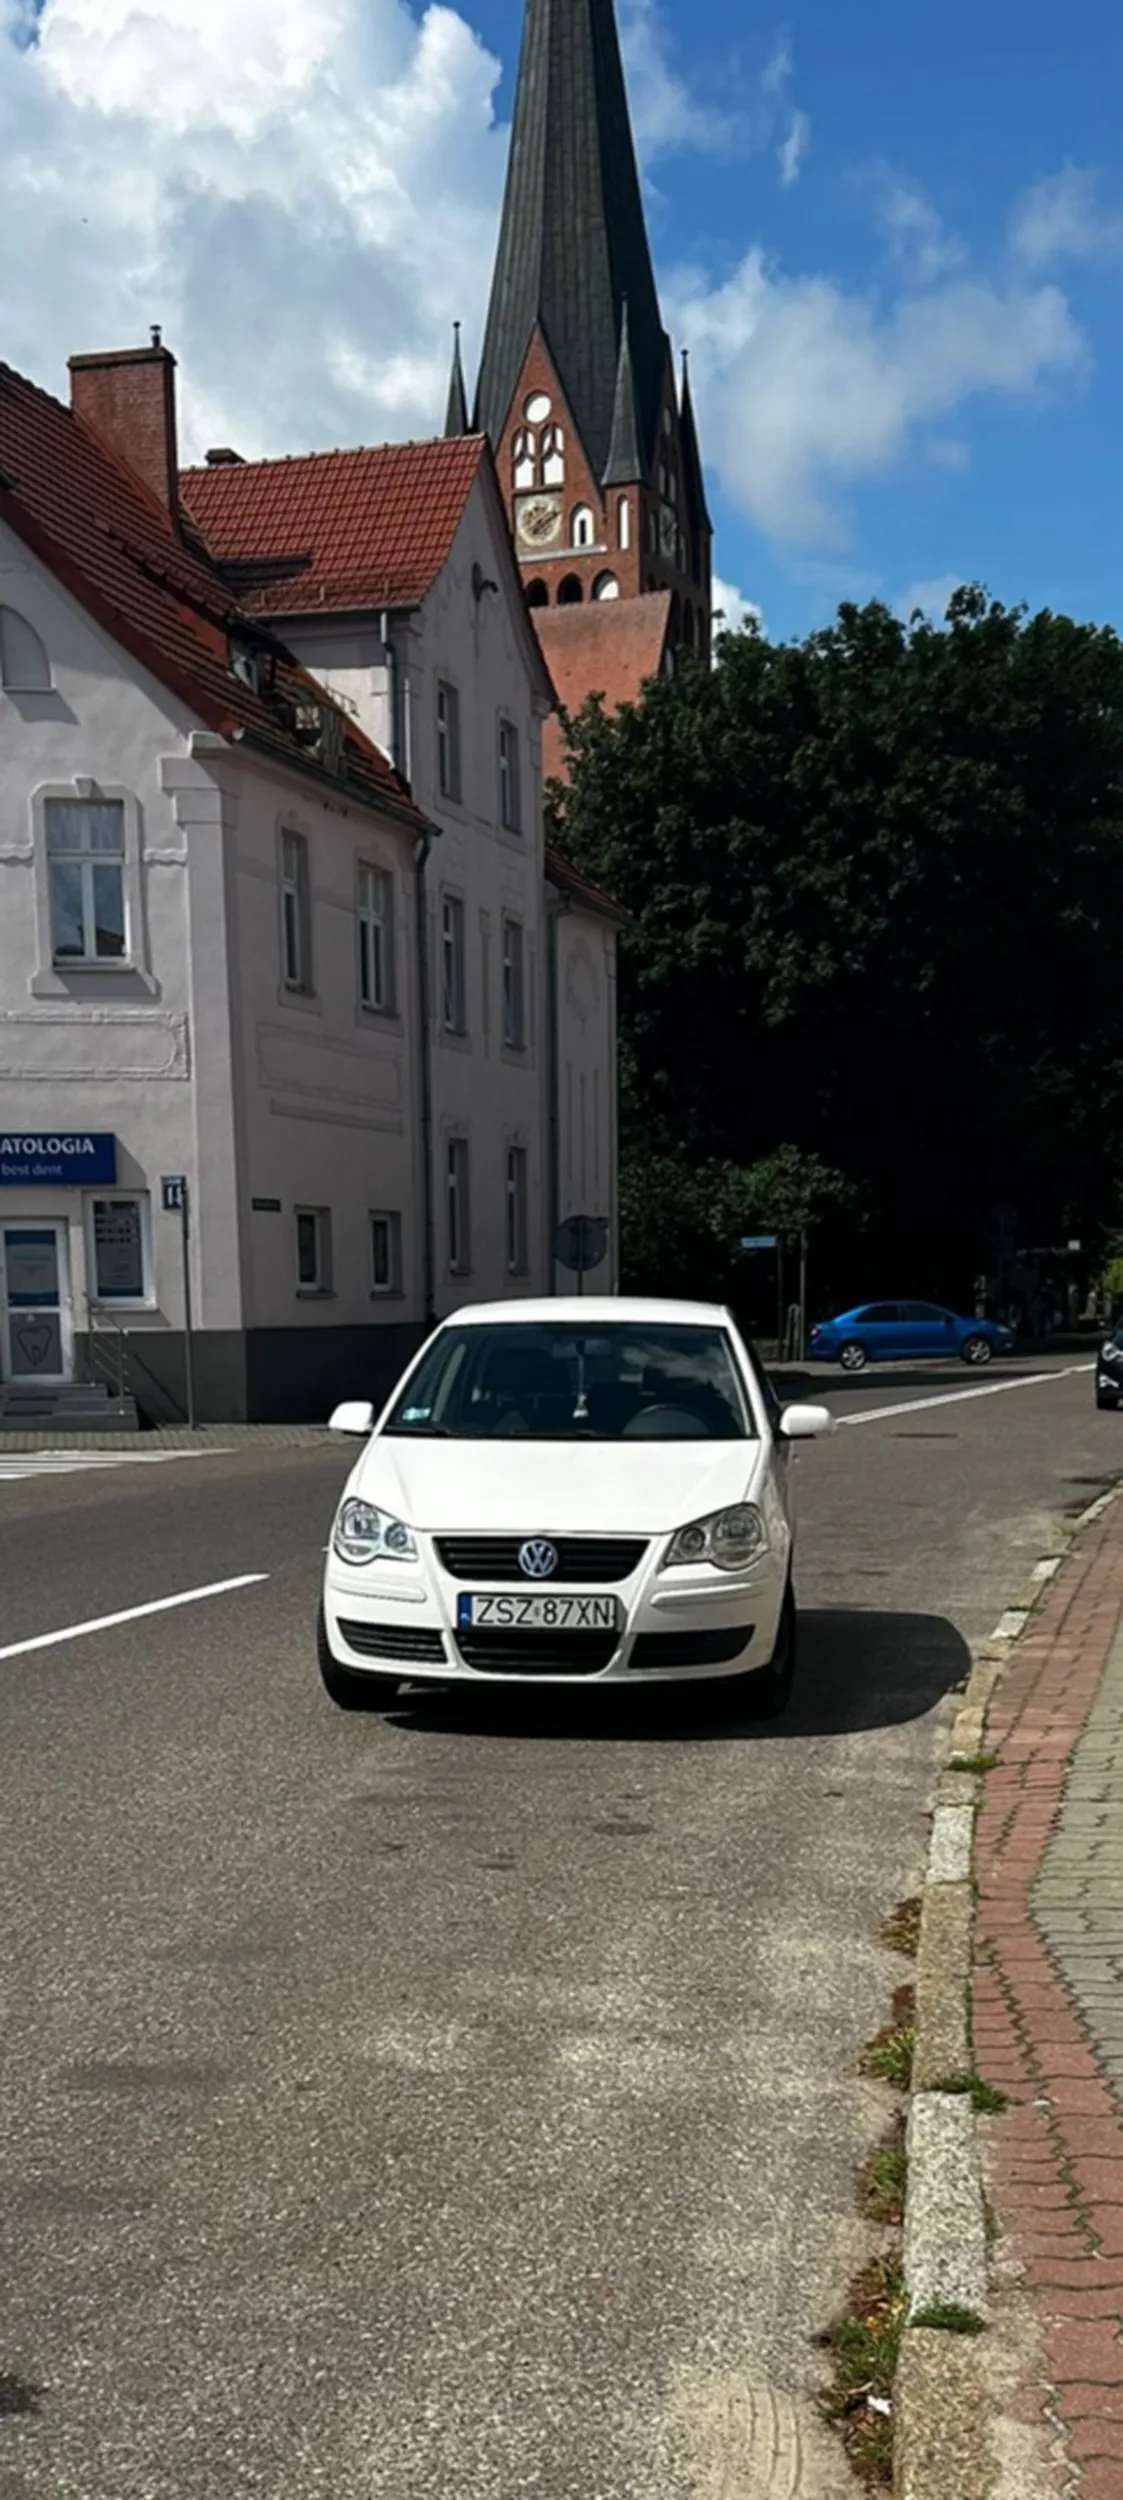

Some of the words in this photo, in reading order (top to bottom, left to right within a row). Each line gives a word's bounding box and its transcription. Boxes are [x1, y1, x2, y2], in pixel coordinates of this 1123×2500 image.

[1, 1164, 29, 1176] best
[32, 1164, 62, 1176] dent
[519, 1540, 557, 1577] VW
[477, 1598, 534, 1624] ZSZ
[543, 1599, 610, 1626] 87XN
